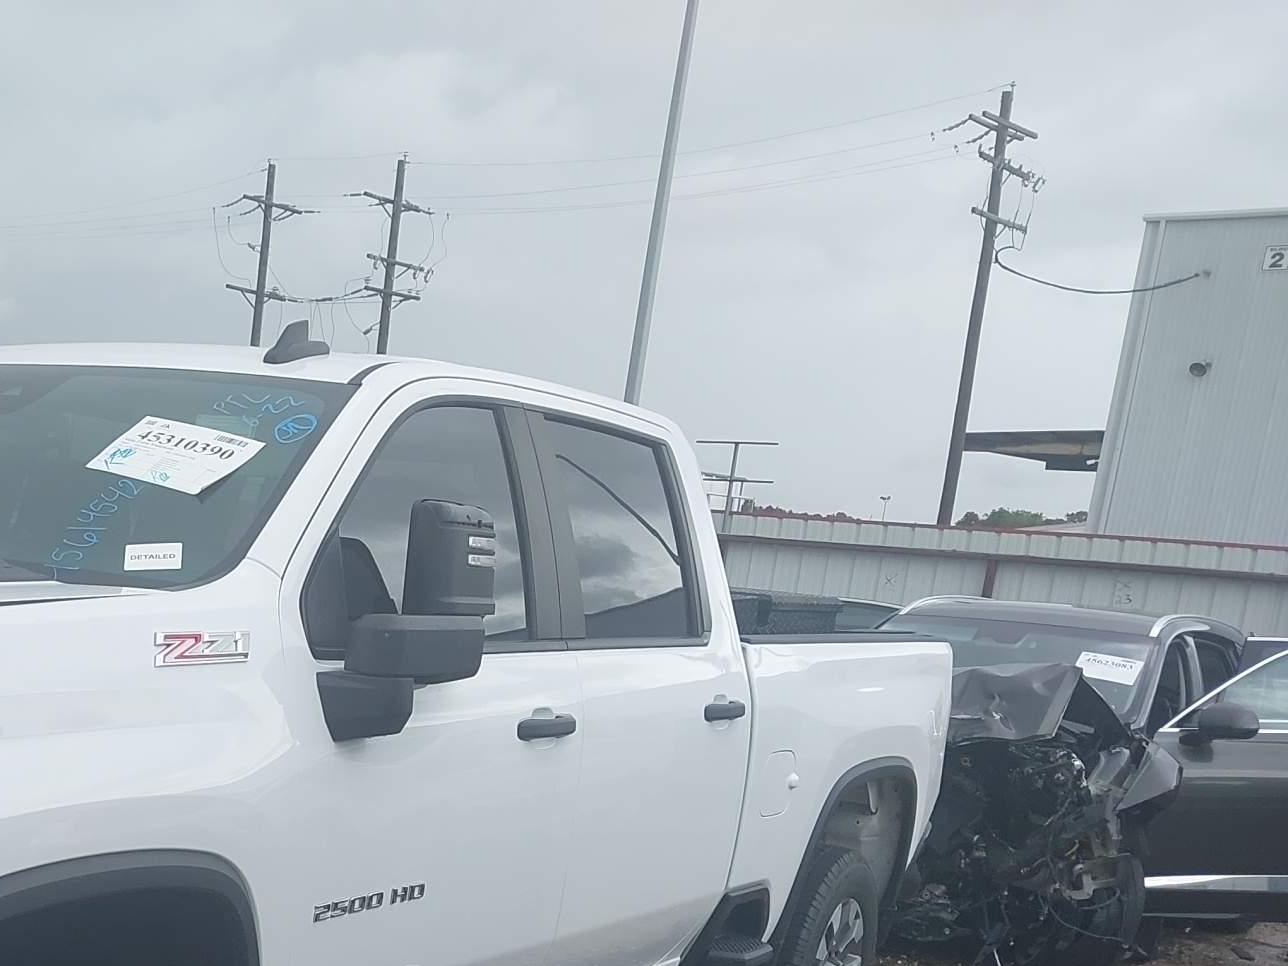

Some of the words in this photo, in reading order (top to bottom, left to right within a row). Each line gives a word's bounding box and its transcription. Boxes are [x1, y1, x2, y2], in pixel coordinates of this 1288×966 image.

[1268, 252, 1285, 268] 2
[137, 429, 236, 461] 45310390
[130, 553, 176, 561] DETAILED
[153, 631, 250, 668] Z71
[312, 891, 384, 923] 2500
[389, 883, 426, 905] HD
